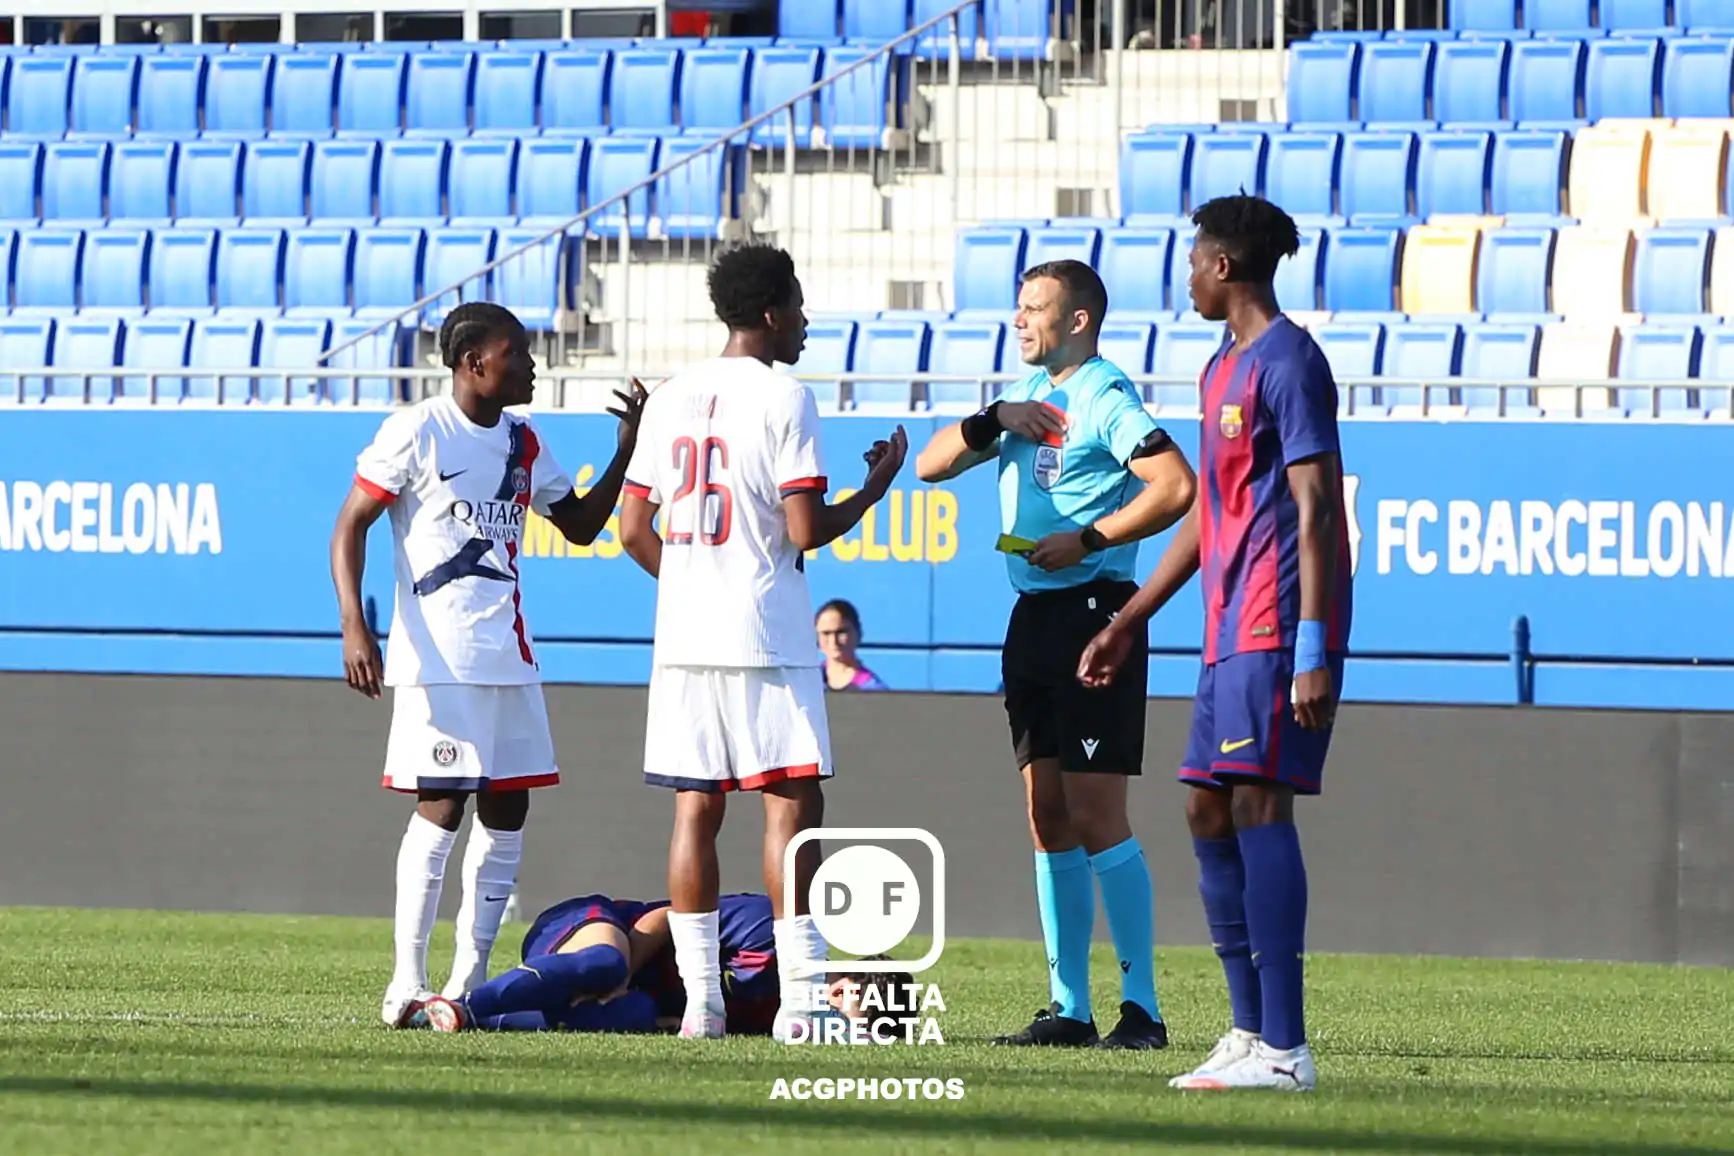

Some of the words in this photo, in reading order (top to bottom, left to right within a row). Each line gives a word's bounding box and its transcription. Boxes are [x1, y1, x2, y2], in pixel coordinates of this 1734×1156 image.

[451, 499, 523, 526] QATAR
[666, 436, 732, 546] 26
[831, 488, 959, 563] CLUB
[1377, 499, 1438, 574] FC
